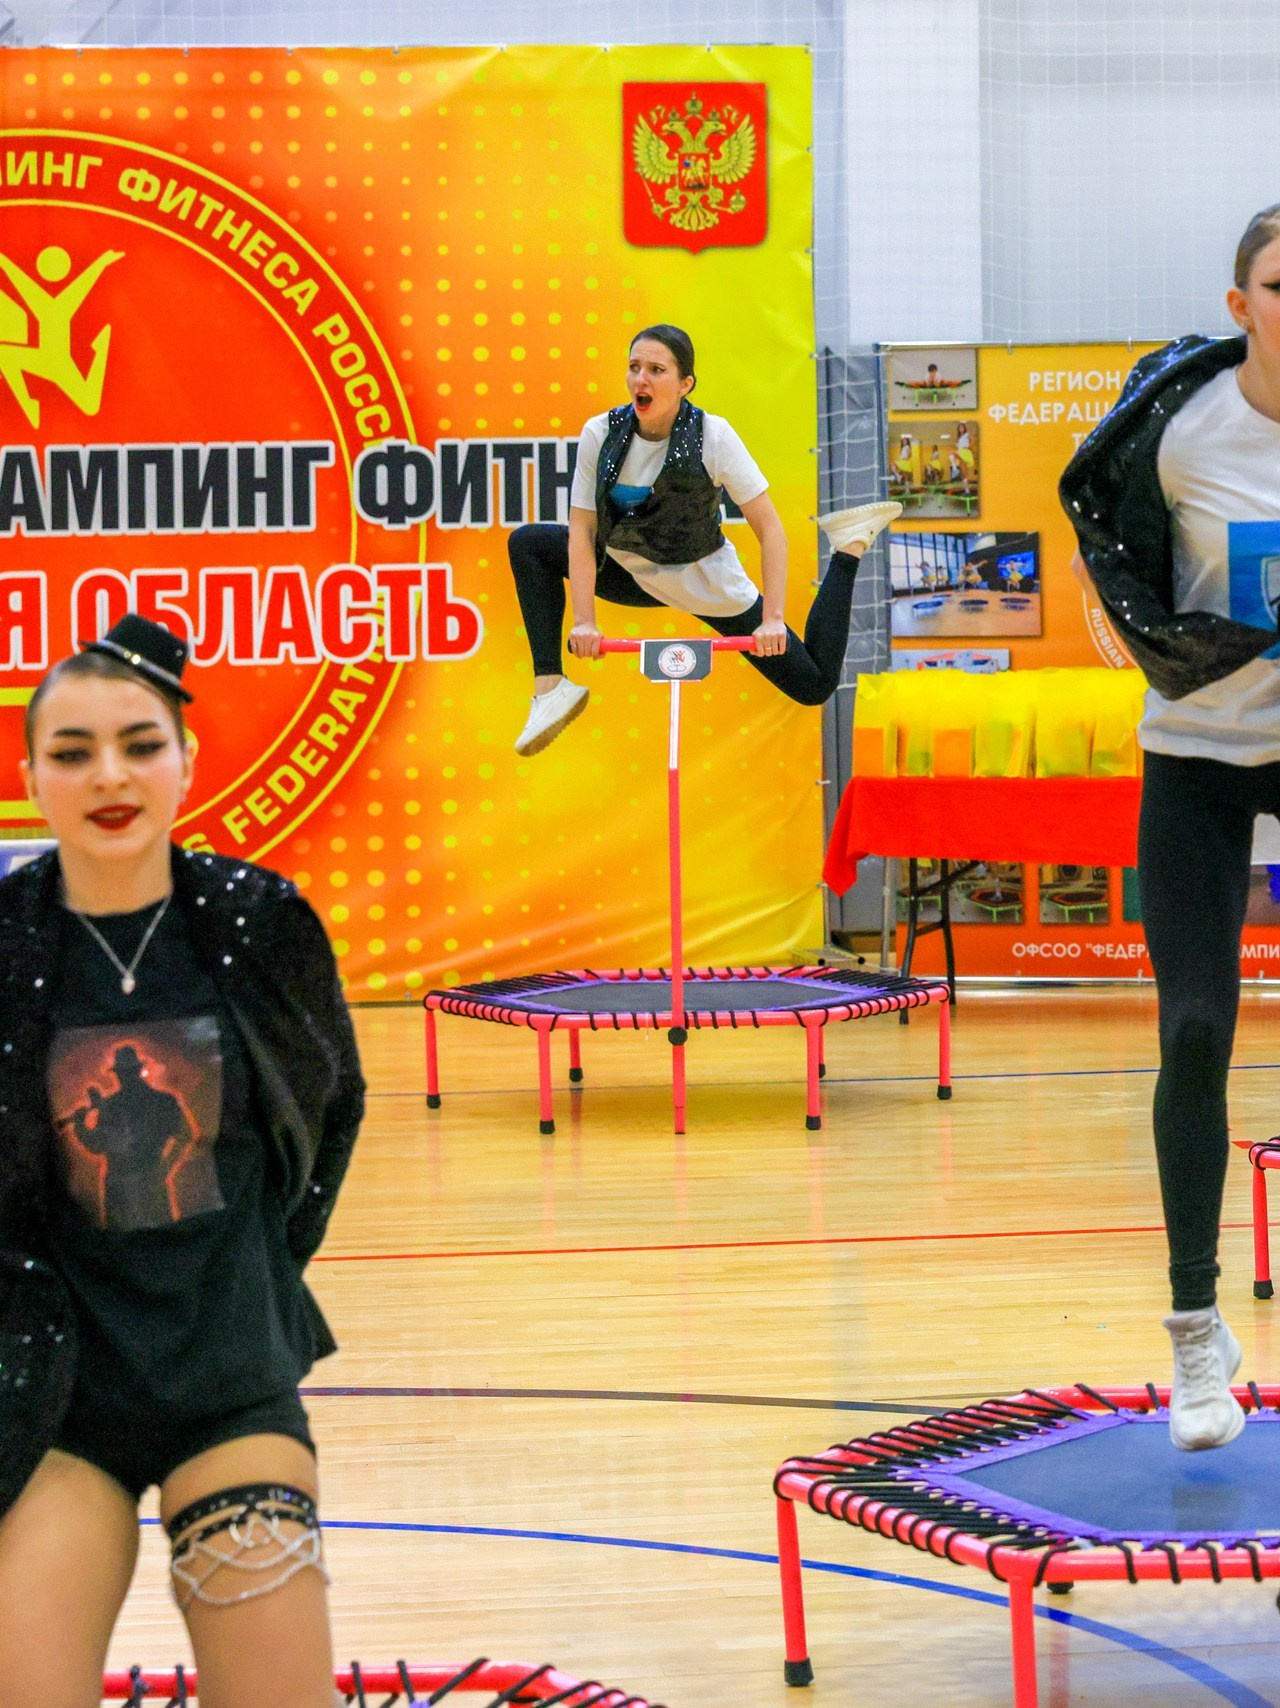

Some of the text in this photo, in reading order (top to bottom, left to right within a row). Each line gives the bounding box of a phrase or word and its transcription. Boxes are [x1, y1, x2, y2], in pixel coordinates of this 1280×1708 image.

[0, 150, 397, 451] ИНГ ФИТНЕСА РОСС
[988, 402, 1110, 425] ФЕДЕРАЦ
[71, 563, 483, 670] ОБЛАСТЬ
[1090, 608, 1127, 668] RUSSIAN
[221, 591, 385, 845] FEDERAT
[1012, 942, 1081, 958] ОФСОО
[1085, 943, 1151, 960] "ФЕДЕР
